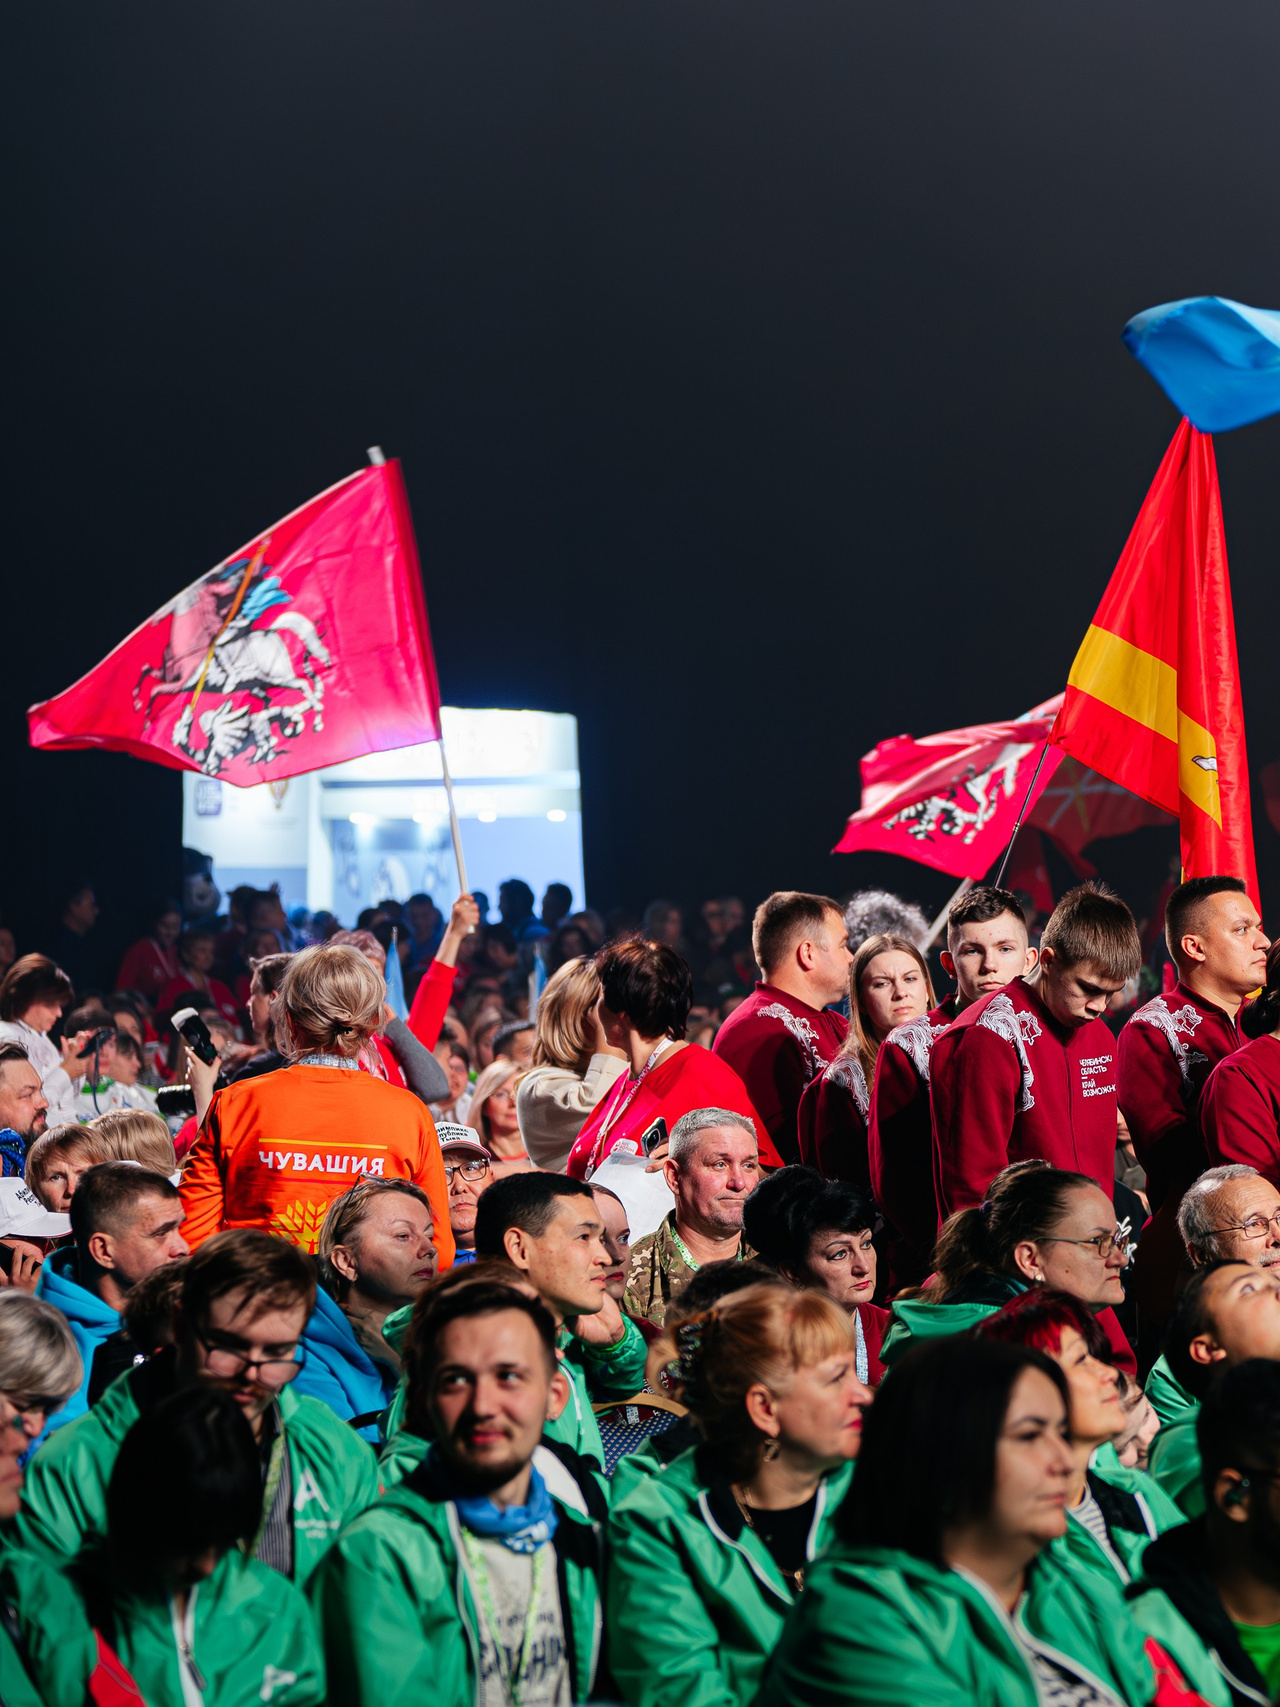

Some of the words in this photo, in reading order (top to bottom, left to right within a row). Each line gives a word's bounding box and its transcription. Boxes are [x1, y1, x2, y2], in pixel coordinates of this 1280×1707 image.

[1080, 1065, 1108, 1076] ОБЛАСТЬ
[1081, 1078, 1096, 1089] КРАЙ
[258, 1150, 385, 1176] ЧУВАШИЯ
